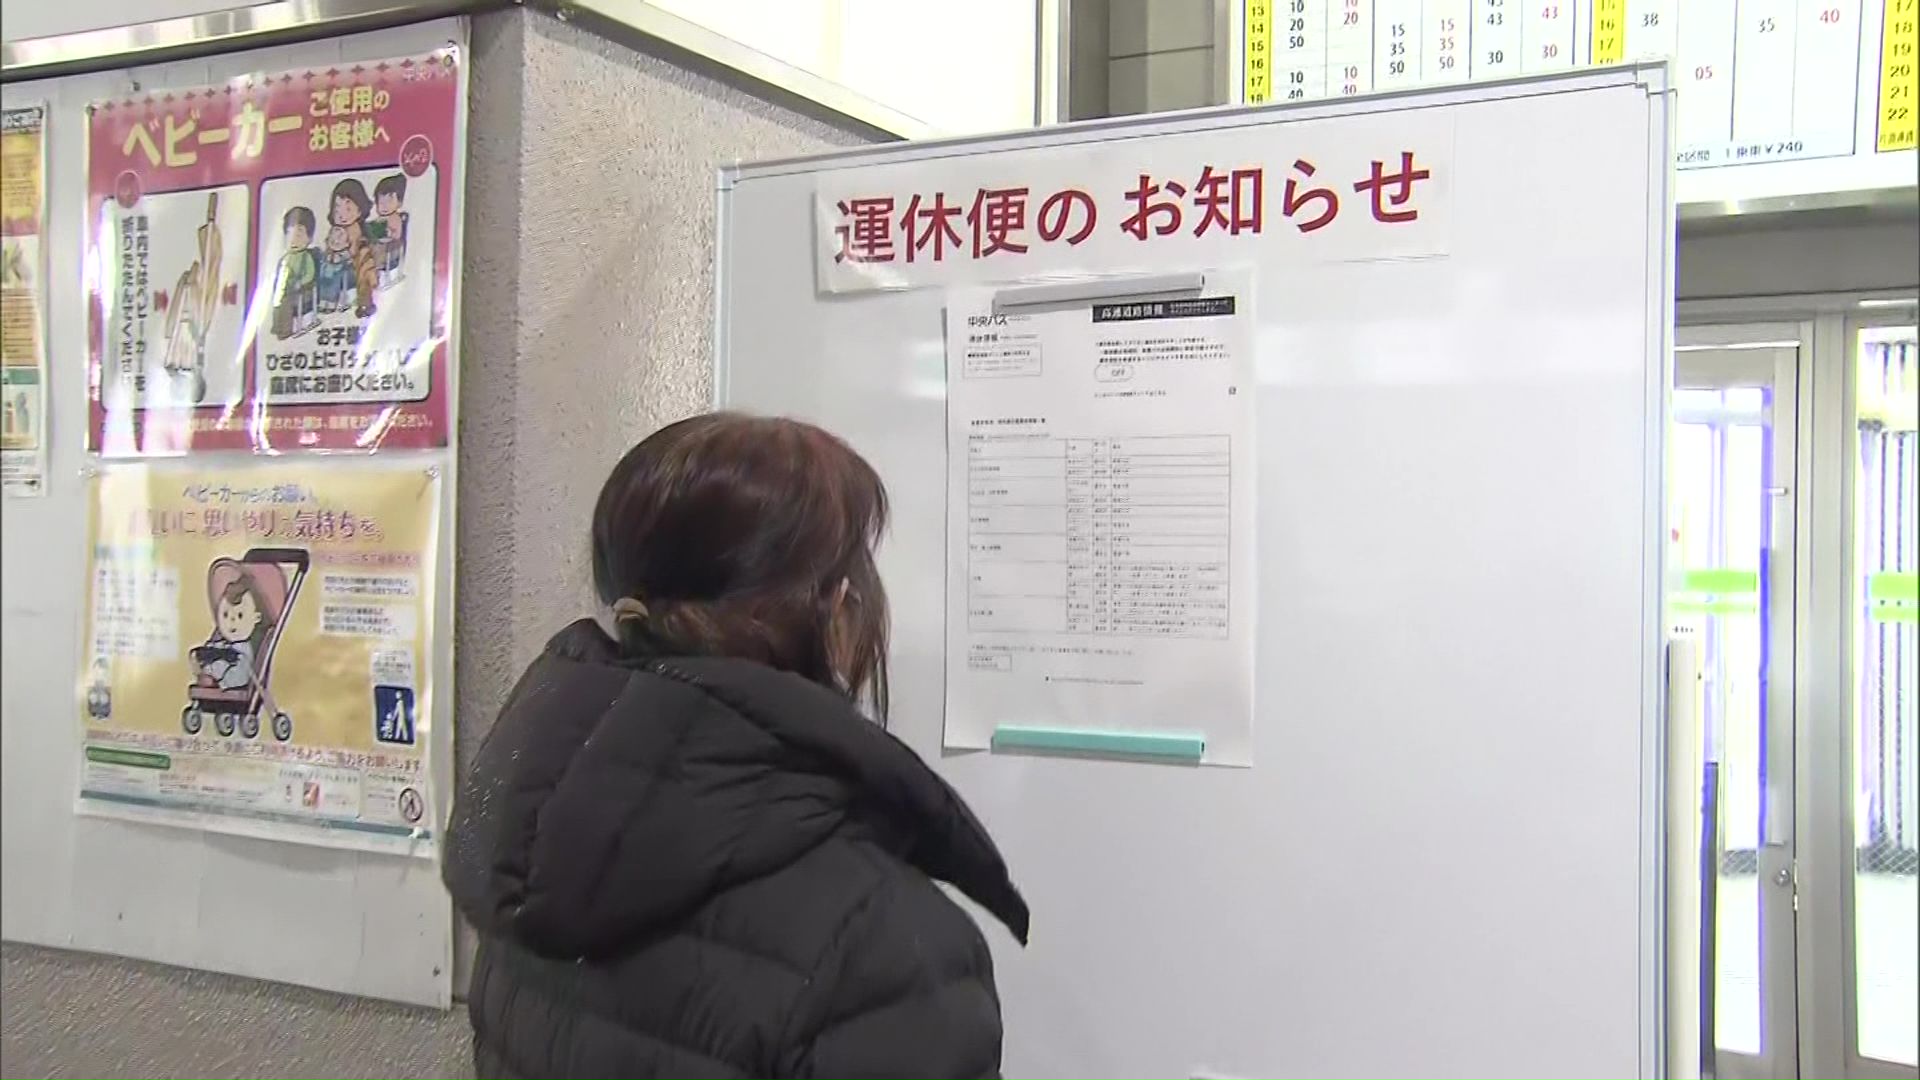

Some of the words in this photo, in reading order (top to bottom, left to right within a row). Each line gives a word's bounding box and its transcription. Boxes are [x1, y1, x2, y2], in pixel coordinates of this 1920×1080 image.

[1290, 1, 1304, 13] 10
[1542, 6, 1558, 20] 43
[1343, 12, 1358, 25] 20
[1487, 12, 1503, 25] 43
[1641, 12, 1659, 27] 38
[1819, 9, 1840, 24] 40
[1290, 18, 1304, 31] 20
[1392, 24, 1405, 37] 15
[1441, 18, 1455, 32] 15
[1758, 18, 1775, 33] 35
[1290, 35, 1304, 49] 50
[1390, 42, 1405, 56] 35
[1440, 37, 1454, 51] 35
[1487, 50, 1503, 65] 30
[1542, 44, 1558, 59] 30
[1389, 60, 1405, 75] 50
[1439, 55, 1454, 70] 50
[1290, 71, 1304, 84] 10
[1344, 66, 1358, 79] 10
[1695, 66, 1713, 81] 05
[1890, 64, 1910, 77] 20
[1890, 85, 1908, 99] 21
[1888, 106, 1908, 121] 22
[122, 102, 303, 168] ベビーカー
[309, 119, 391, 151] お客様へ
